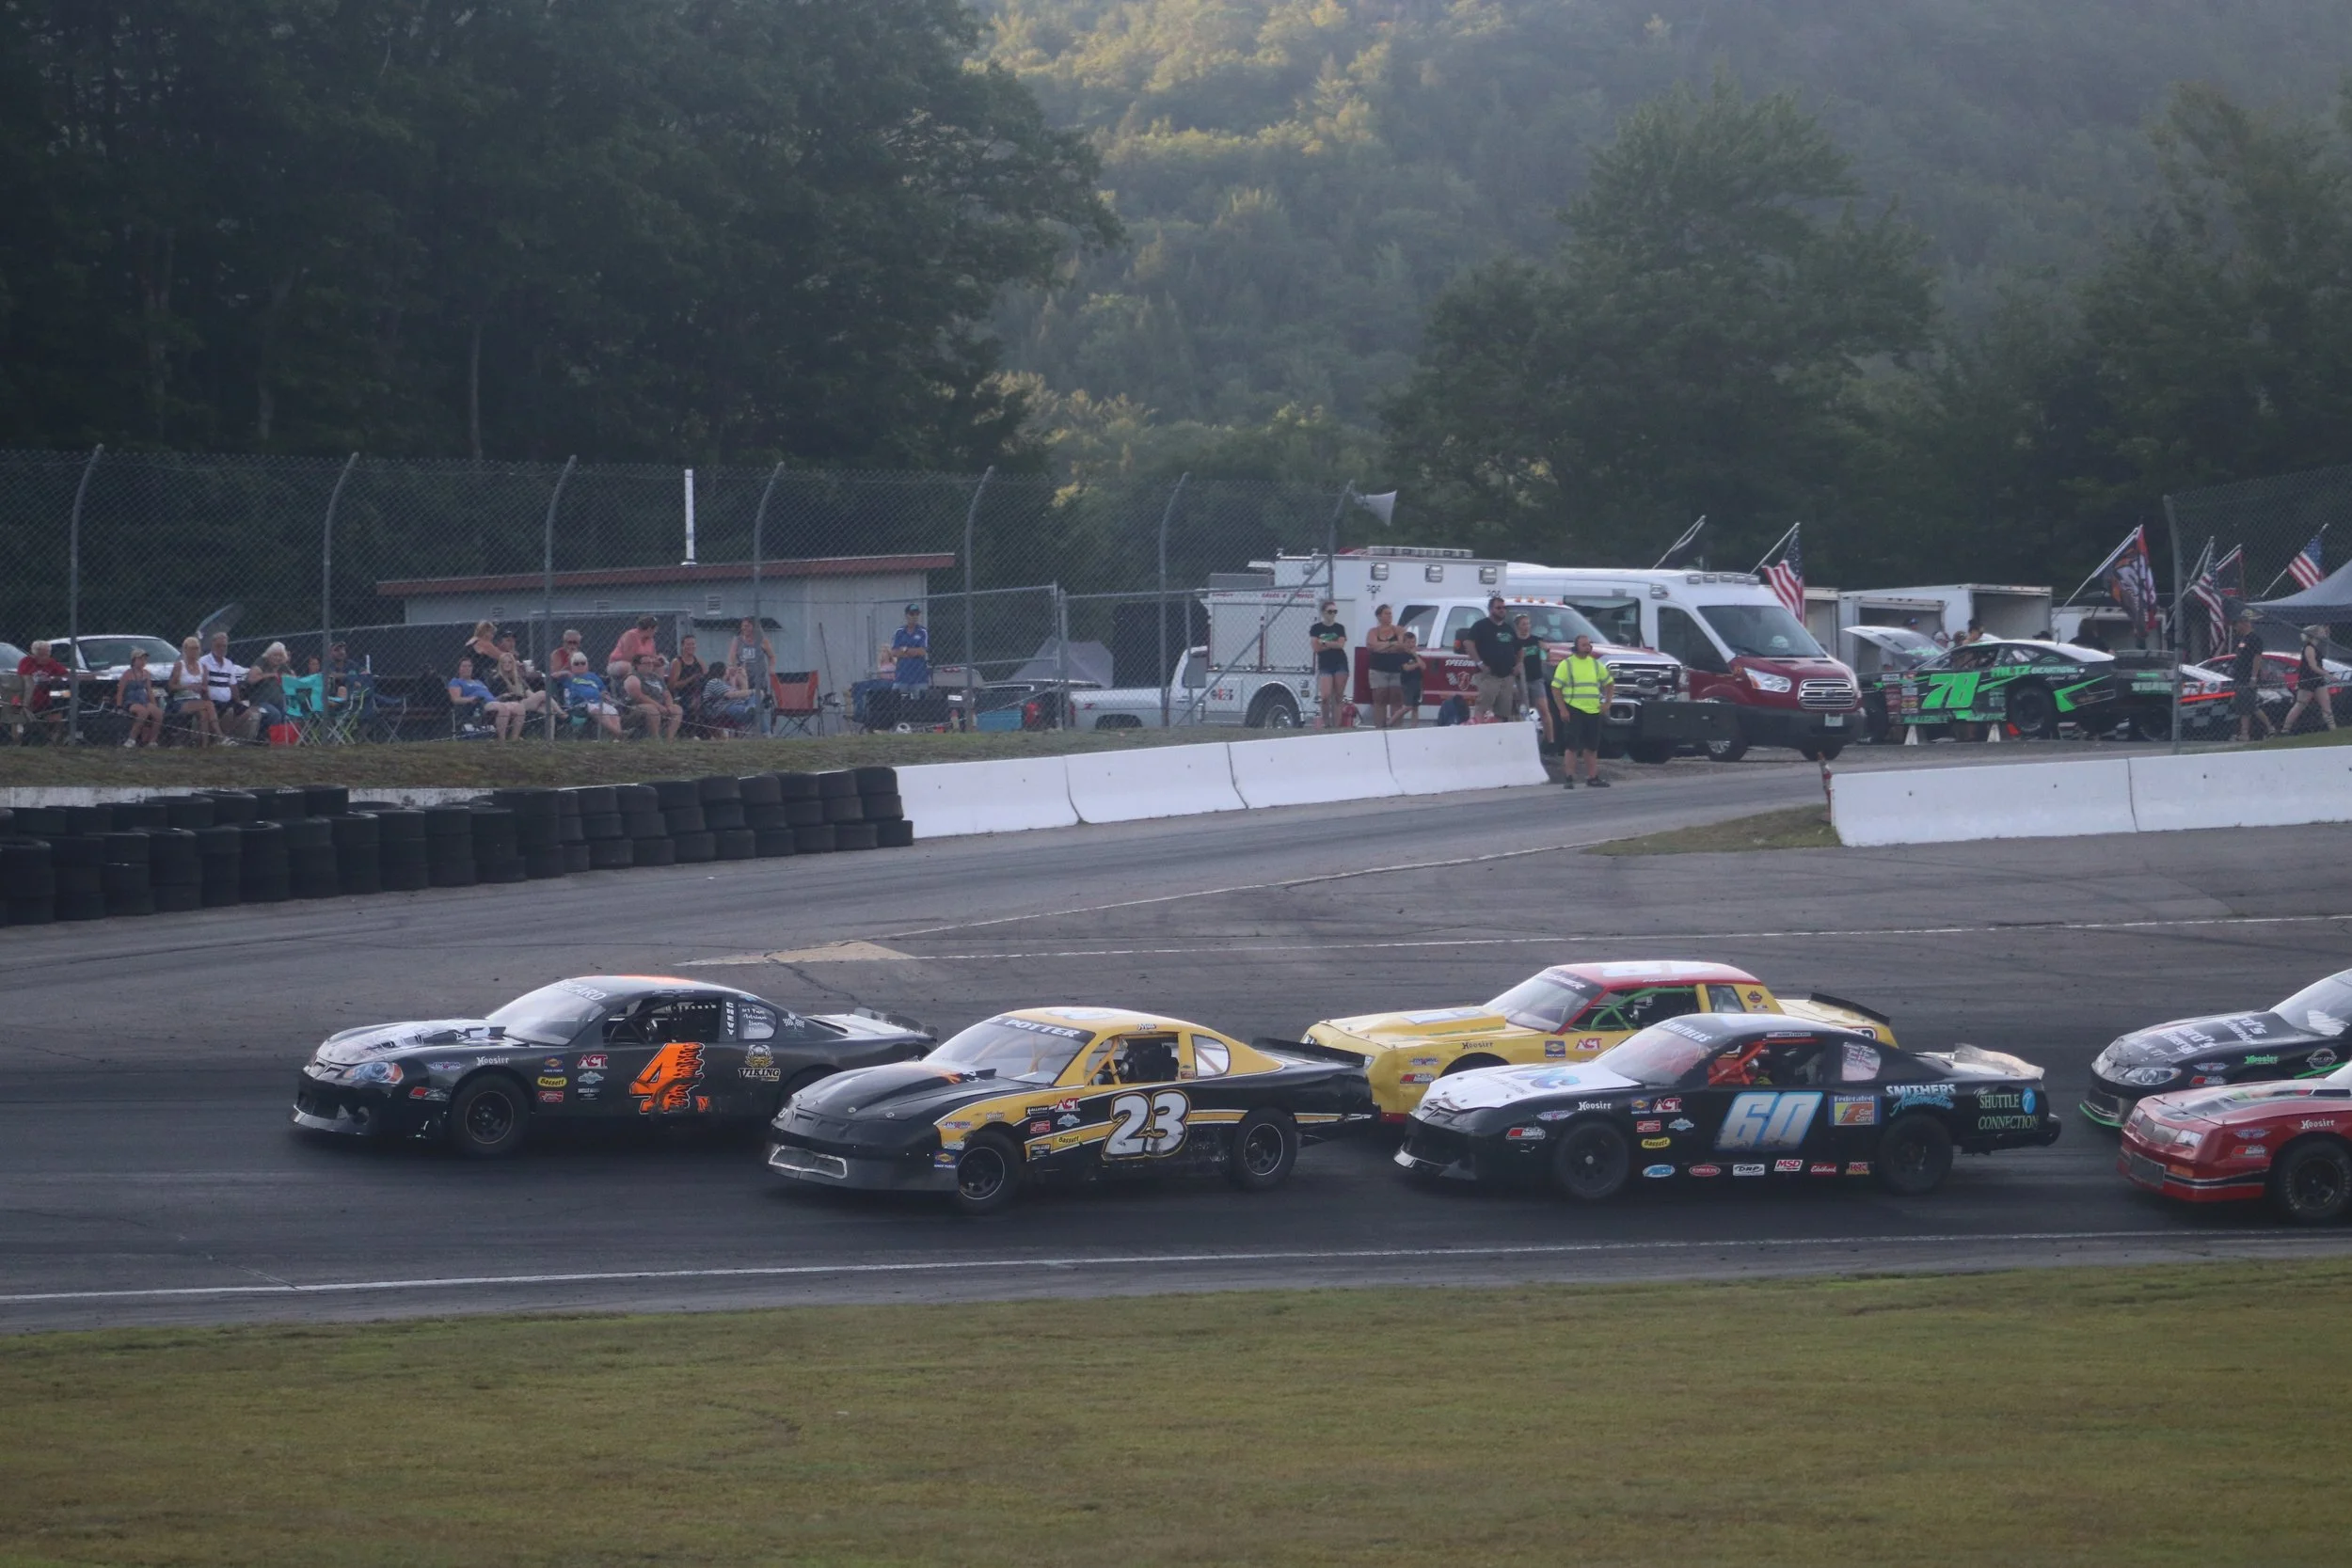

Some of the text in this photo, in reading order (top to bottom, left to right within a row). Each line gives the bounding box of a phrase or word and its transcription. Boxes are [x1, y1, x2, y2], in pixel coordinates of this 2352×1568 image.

[1921, 672, 1980, 709] 78
[725, 1001, 735, 1036] CHEVY
[1004, 1019, 1081, 1037] POTTER
[476, 1055, 509, 1067] Hoosier
[578, 1053, 609, 1069] ACT
[628, 1041, 706, 1116] 4
[738, 1068, 780, 1079] VIKING
[1885, 1084, 1956, 1097] SMITHERS
[1577, 1101, 1612, 1111] Hoosier
[1652, 1097, 1682, 1113] ACT
[1979, 1094, 2020, 1109] SHUTTLE
[1102, 1088, 1191, 1161] 23
[1713, 1091, 1823, 1150] 60
[1978, 1115, 2040, 1130] CONNECTION
[2300, 1119, 2335, 1130] Hoosier
[1777, 1159, 1802, 1168] MSD
